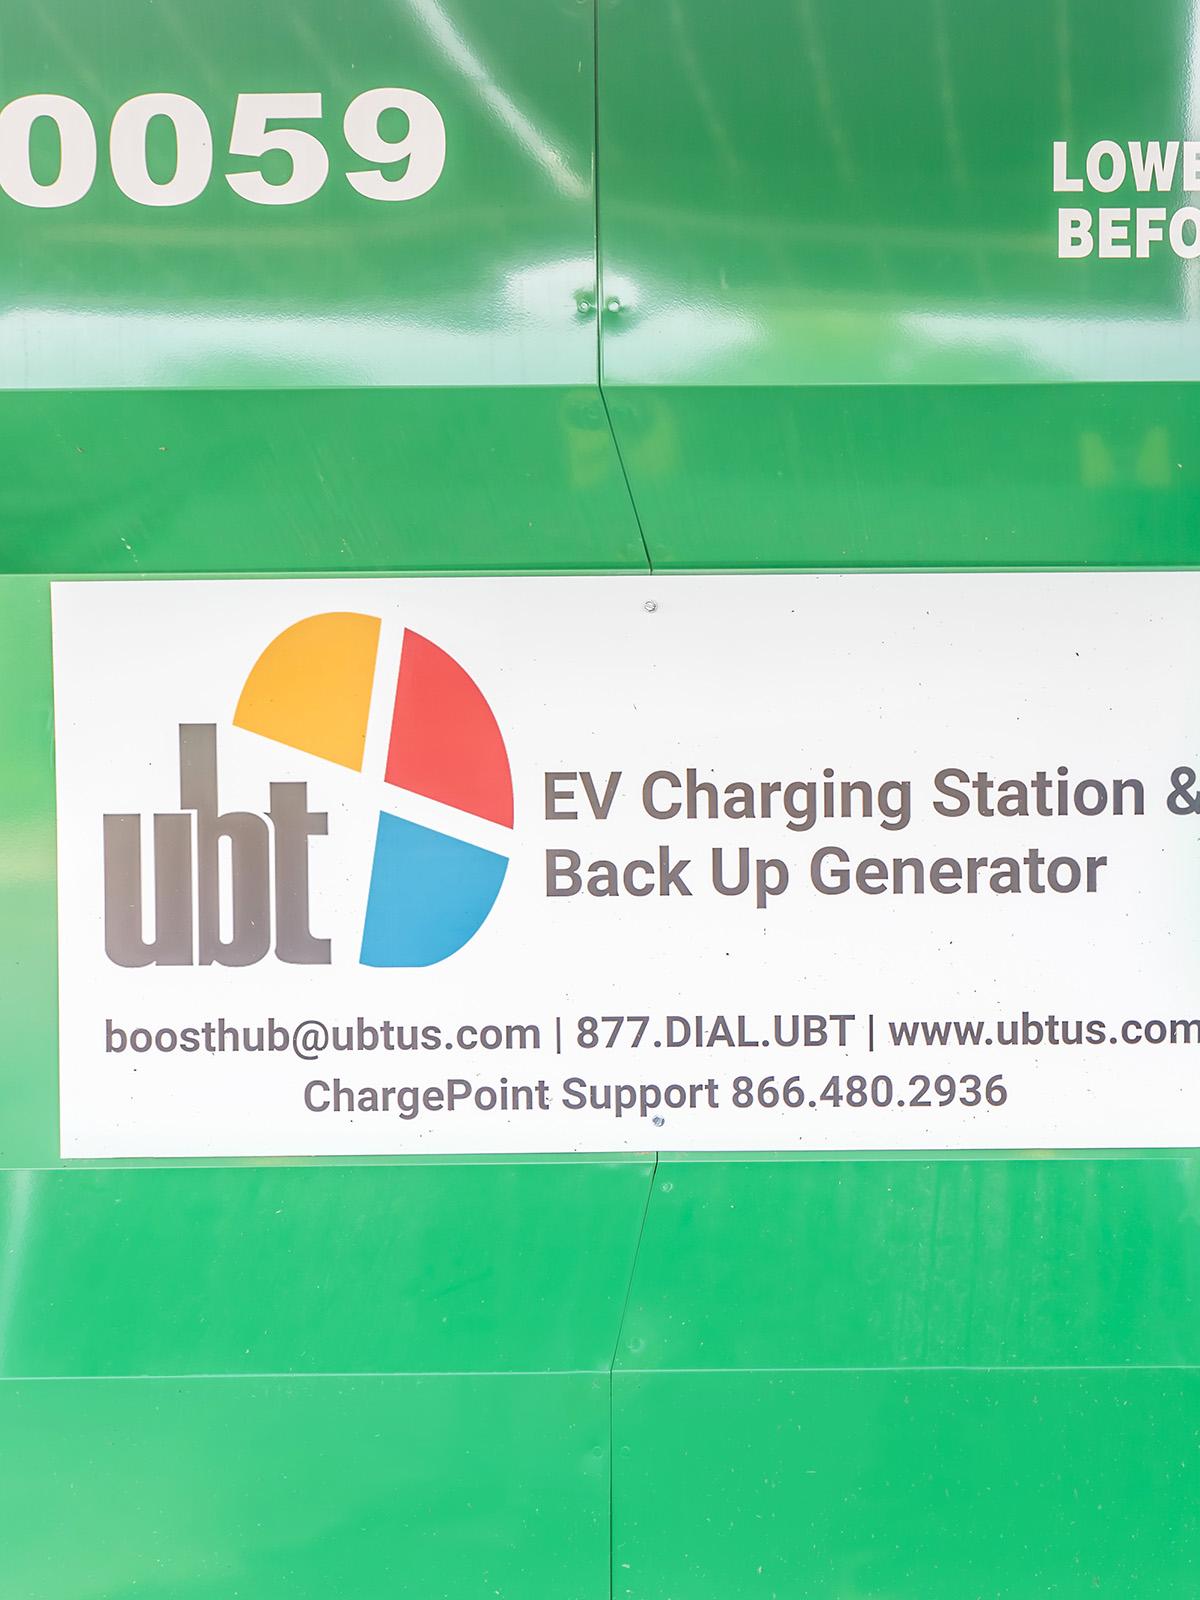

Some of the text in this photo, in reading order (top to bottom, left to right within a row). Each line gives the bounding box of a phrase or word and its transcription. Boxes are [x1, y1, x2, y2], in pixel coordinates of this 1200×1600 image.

[0, 87, 446, 208] 0059
[544, 770, 623, 821] EV
[642, 767, 912, 833] Charging
[932, 766, 1145, 818] Station
[102, 722, 332, 969] ubt
[545, 844, 1108, 910] Back Up Generator
[105, 1016, 541, 1061] boosthub@ubtus.com
[576, 1014, 856, 1049] 877.DIAL.UBT
[304, 1073, 1008, 1121] ChargePoint Support 866.480.2936
